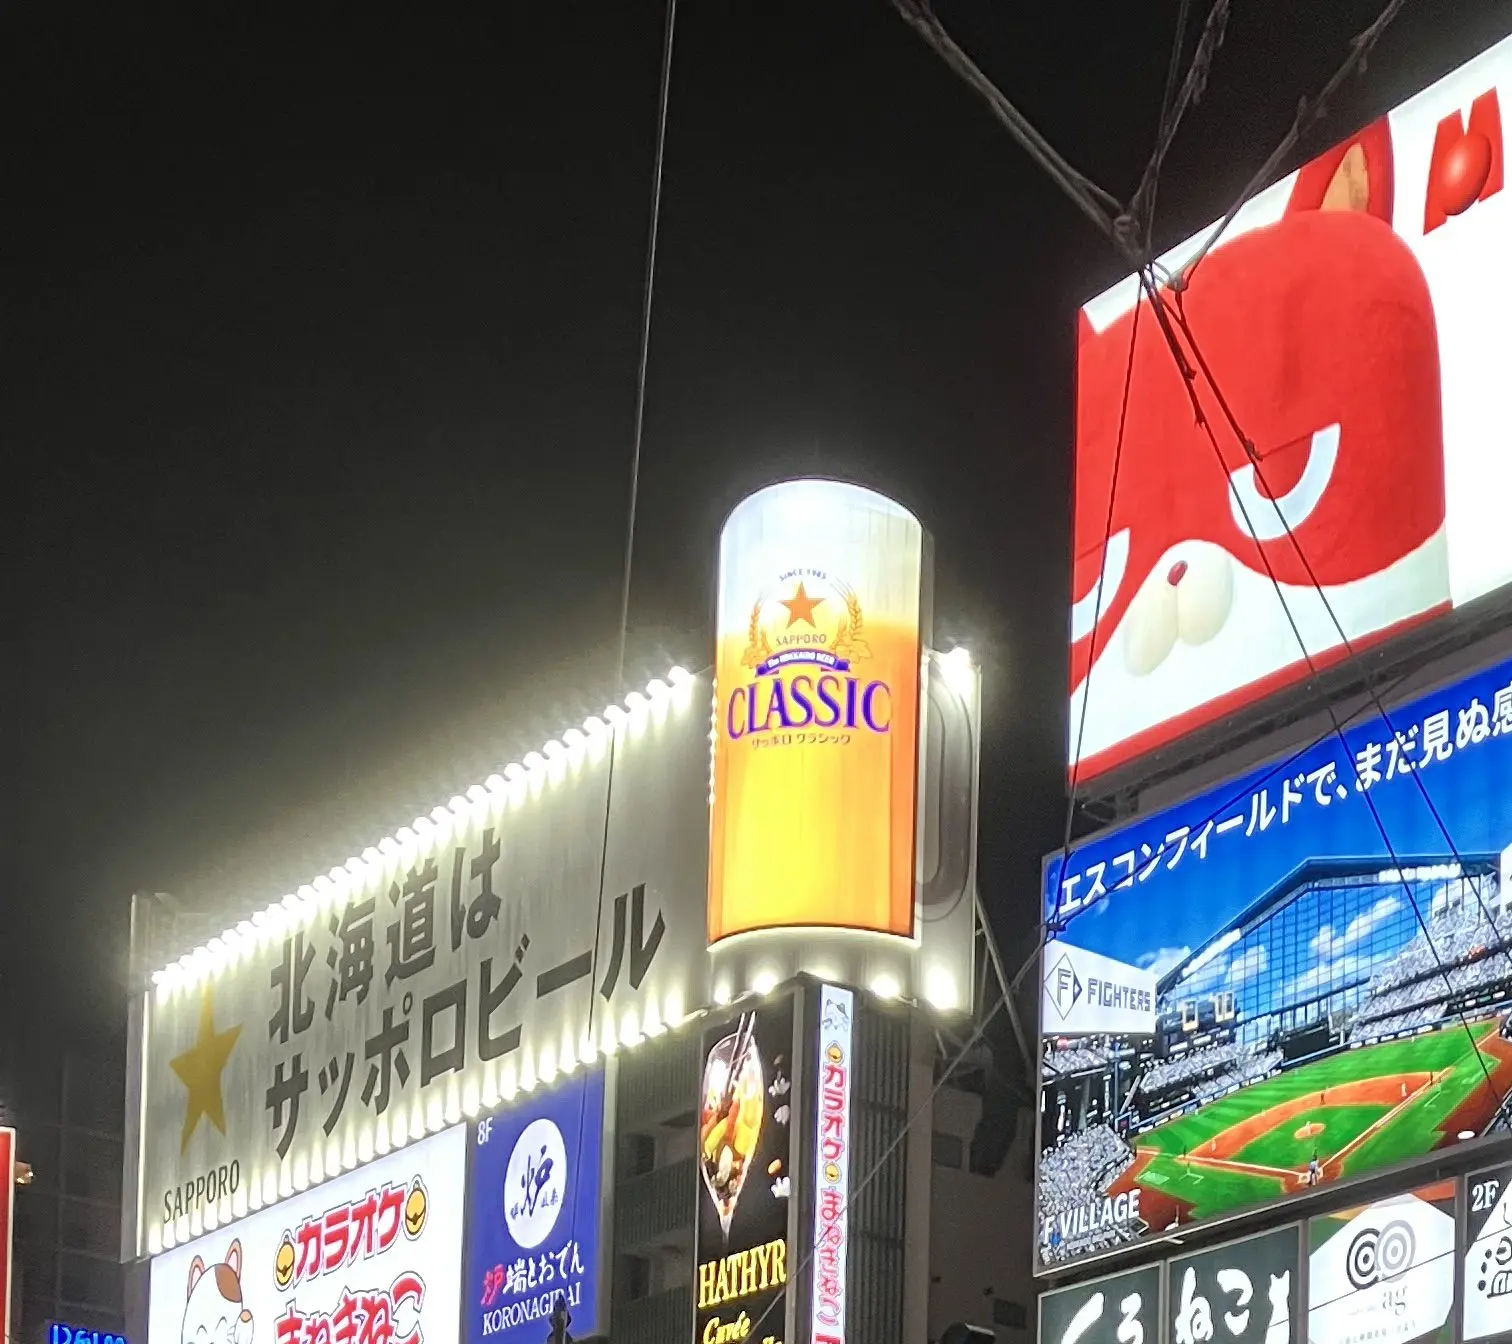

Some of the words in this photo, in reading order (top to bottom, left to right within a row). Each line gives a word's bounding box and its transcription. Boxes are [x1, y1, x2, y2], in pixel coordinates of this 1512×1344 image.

[776, 633, 827, 647] SAPPORO
[727, 675, 891, 740] CLASSIC
[796, 732, 851, 746] クラシック
[268, 827, 503, 1045] 北海道は
[265, 882, 666, 1161] サッポロビール
[1087, 977, 1151, 1013] FIGHTERS
[477, 1117, 493, 1145] 8F
[824, 1062, 847, 1161] カラオケ
[162, 1158, 241, 1225] SAPPORO
[1059, 1187, 1142, 1238] VILLAGE
[1471, 1180, 1499, 1212] 2F
[296, 1188, 406, 1280] カラオケ
[818, 1187, 847, 1328] まねきねこ
[481, 1239, 585, 1306] 炉端とおでん
[698, 1237, 787, 1309] HATHYR
